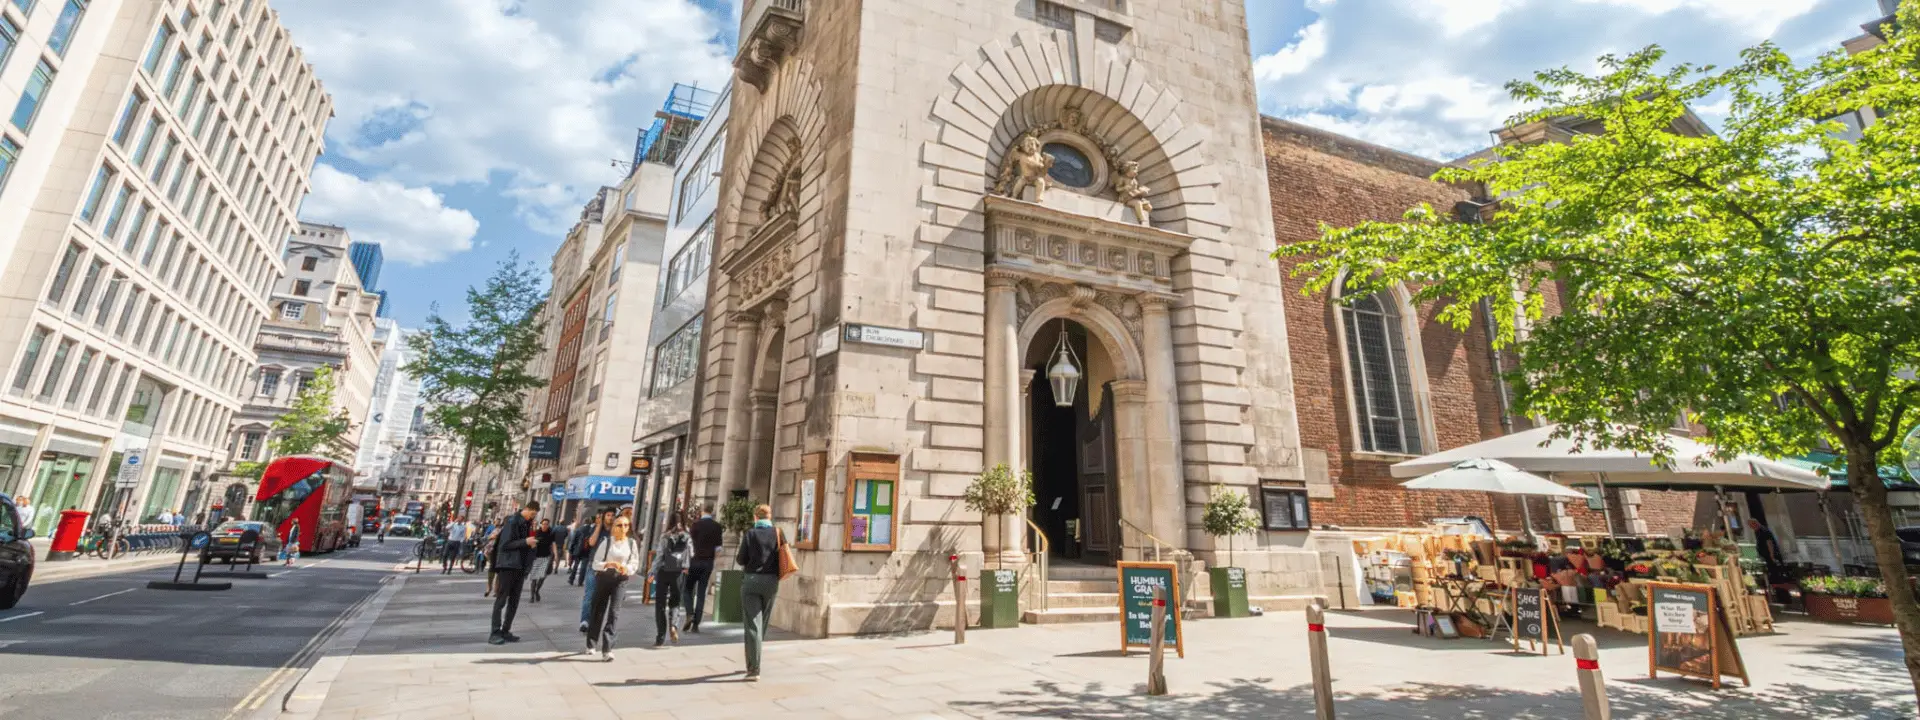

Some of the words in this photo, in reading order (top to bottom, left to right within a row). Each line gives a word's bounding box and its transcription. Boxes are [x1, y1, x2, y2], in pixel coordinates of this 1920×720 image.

[599, 481, 636, 496] Pure
[1130, 576, 1165, 586] HUMBLE
[1133, 584, 1156, 595] GRA
[1128, 611, 1137, 619] In
[1138, 611, 1150, 620] the
[1139, 621, 1152, 629] Bel
